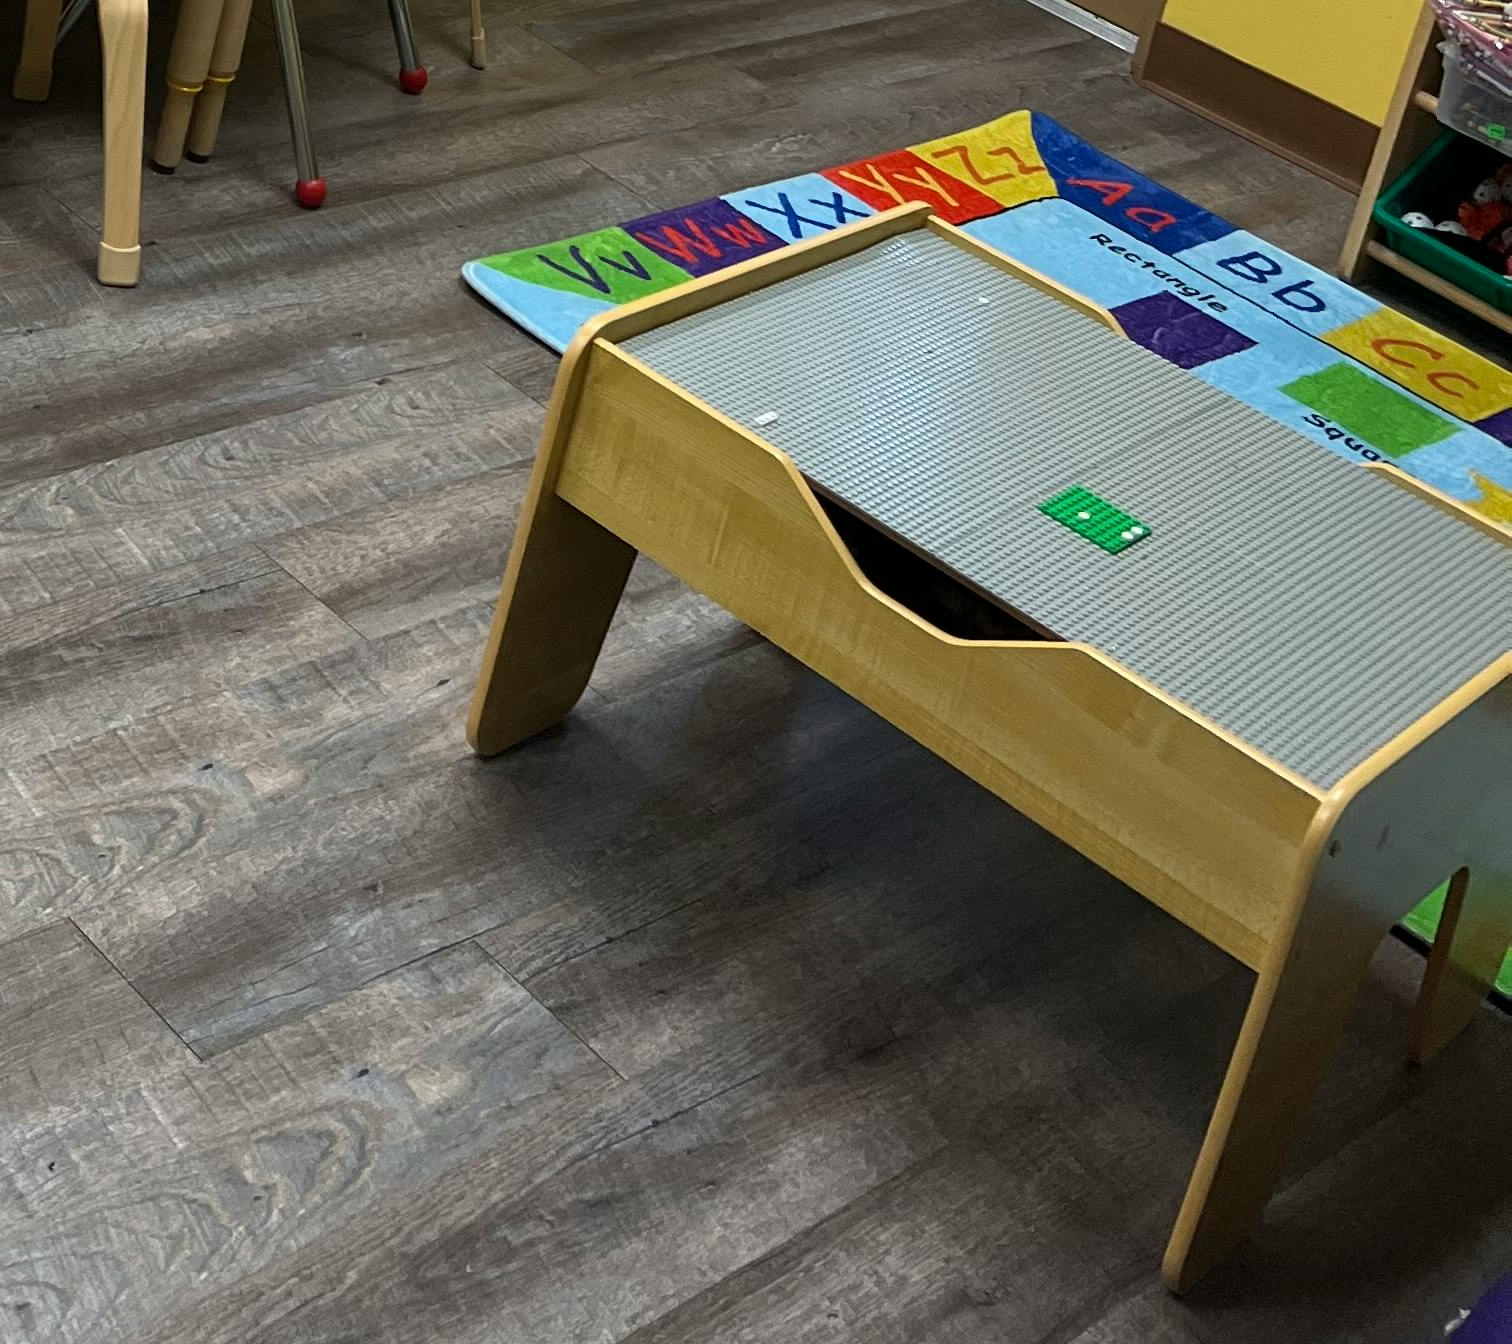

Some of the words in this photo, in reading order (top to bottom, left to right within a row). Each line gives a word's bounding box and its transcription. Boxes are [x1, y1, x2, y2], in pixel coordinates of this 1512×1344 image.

[838, 164, 960, 206] Yy
[931, 145, 1046, 186] Zz
[745, 192, 871, 239] Xx
[635, 217, 768, 263] Ww
[537, 244, 651, 295] Vv
[1089, 233, 1229, 313] Rectangle
